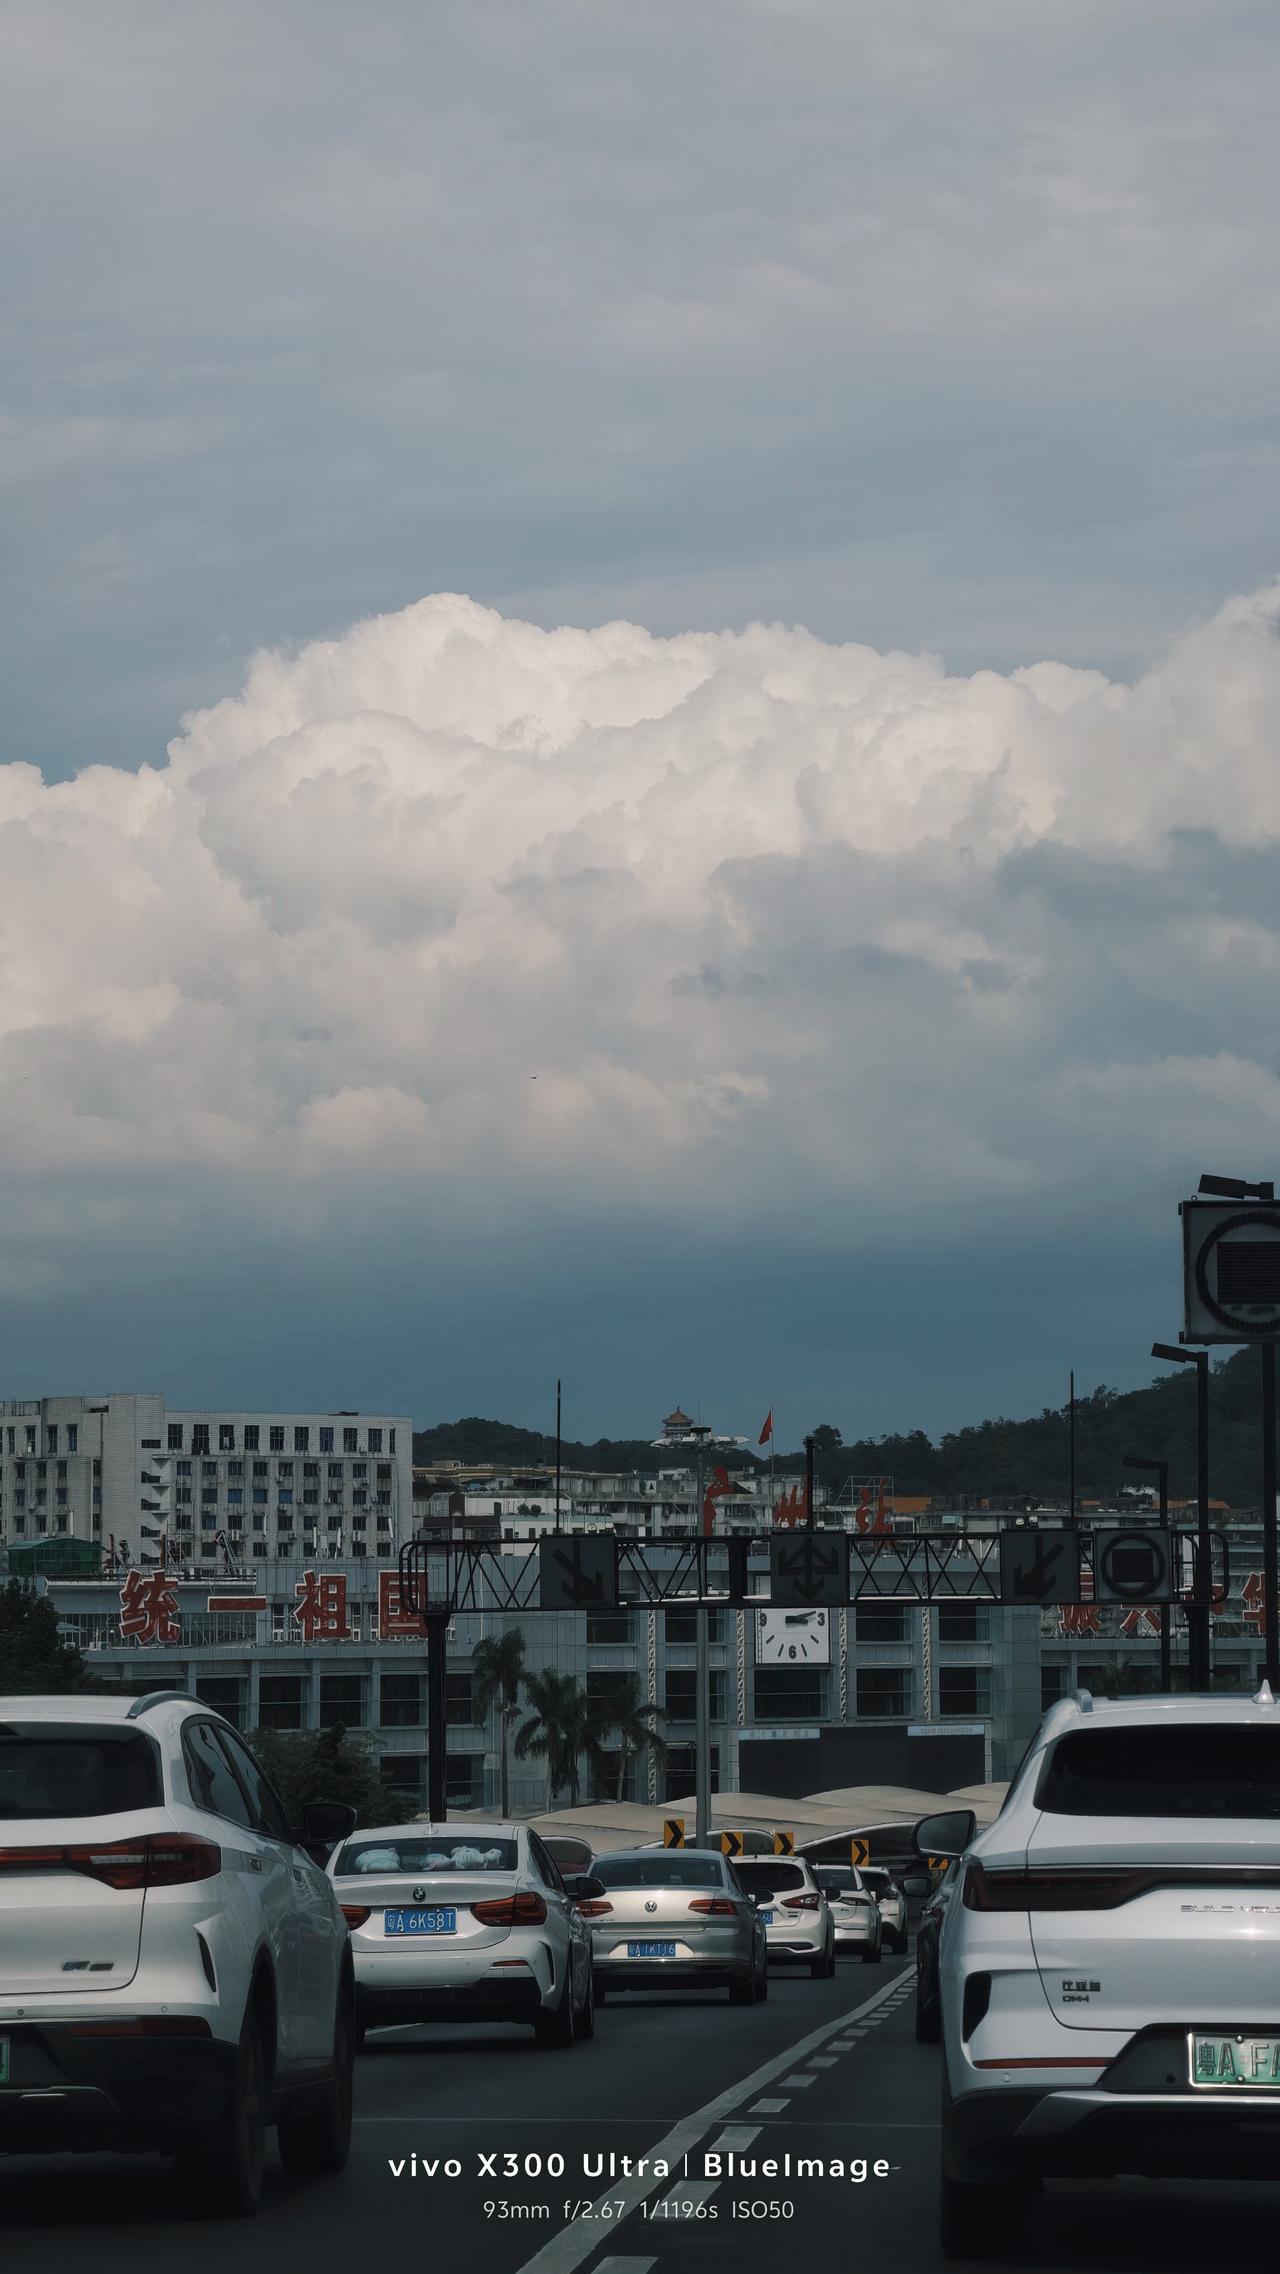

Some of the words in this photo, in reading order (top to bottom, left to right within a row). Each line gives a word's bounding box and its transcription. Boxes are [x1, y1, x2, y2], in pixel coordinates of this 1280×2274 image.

[119, 1569, 429, 1644] 统一祖国
[759, 1612, 768, 1627] 9
[817, 1612, 826, 1626] 3
[788, 1645, 797, 1659] 6
